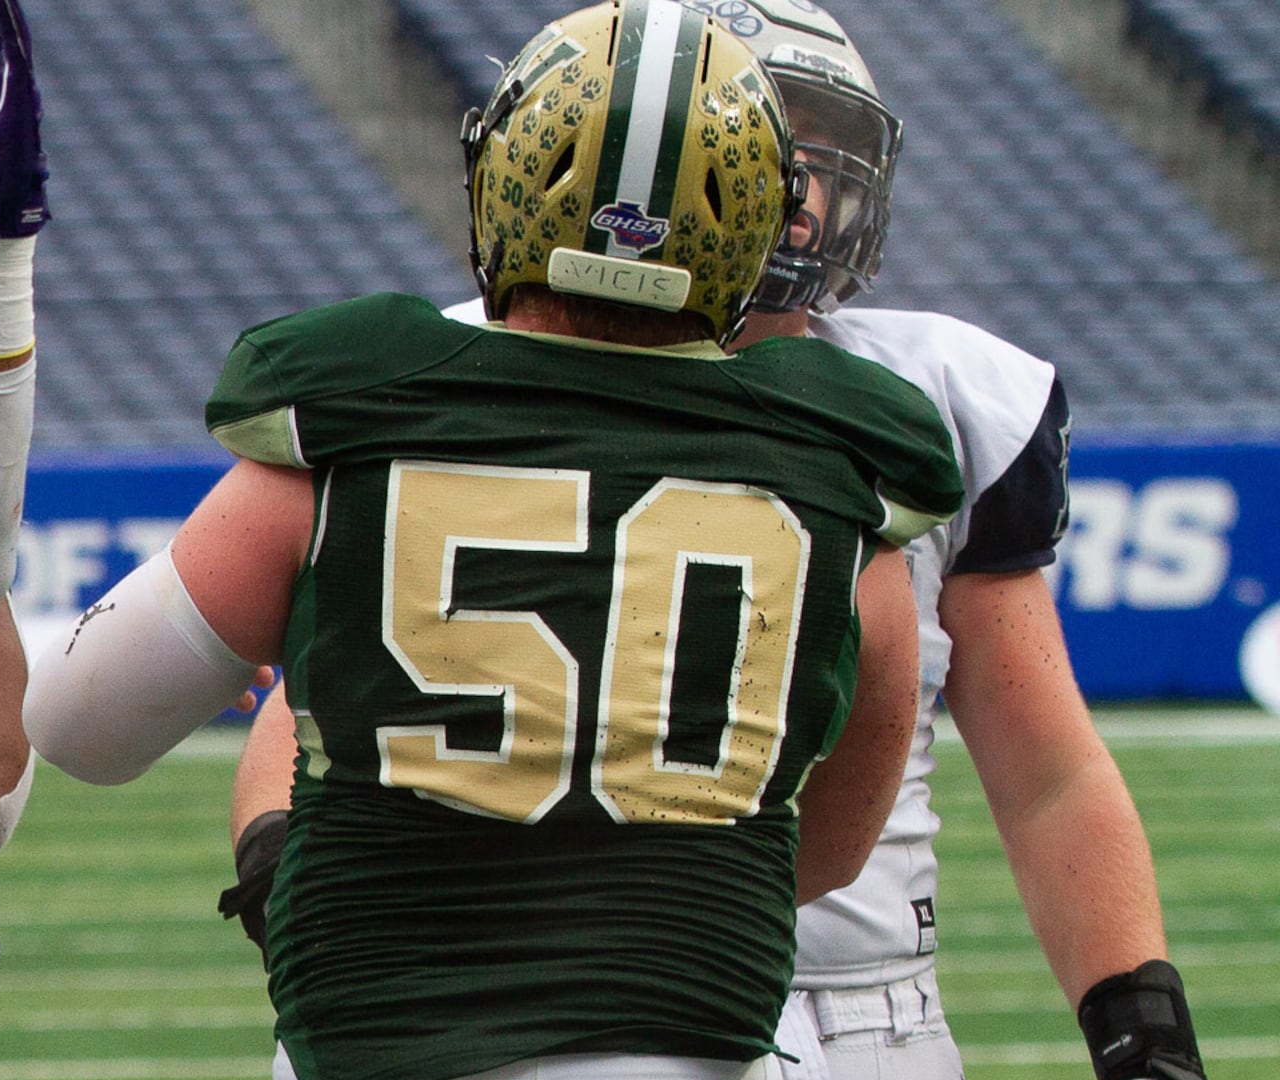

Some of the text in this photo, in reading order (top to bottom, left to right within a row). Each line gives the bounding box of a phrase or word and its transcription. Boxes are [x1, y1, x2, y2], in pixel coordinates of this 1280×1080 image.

[500, 175, 524, 208] 50
[596, 213, 665, 235] GHSA
[376, 459, 811, 825] 50
